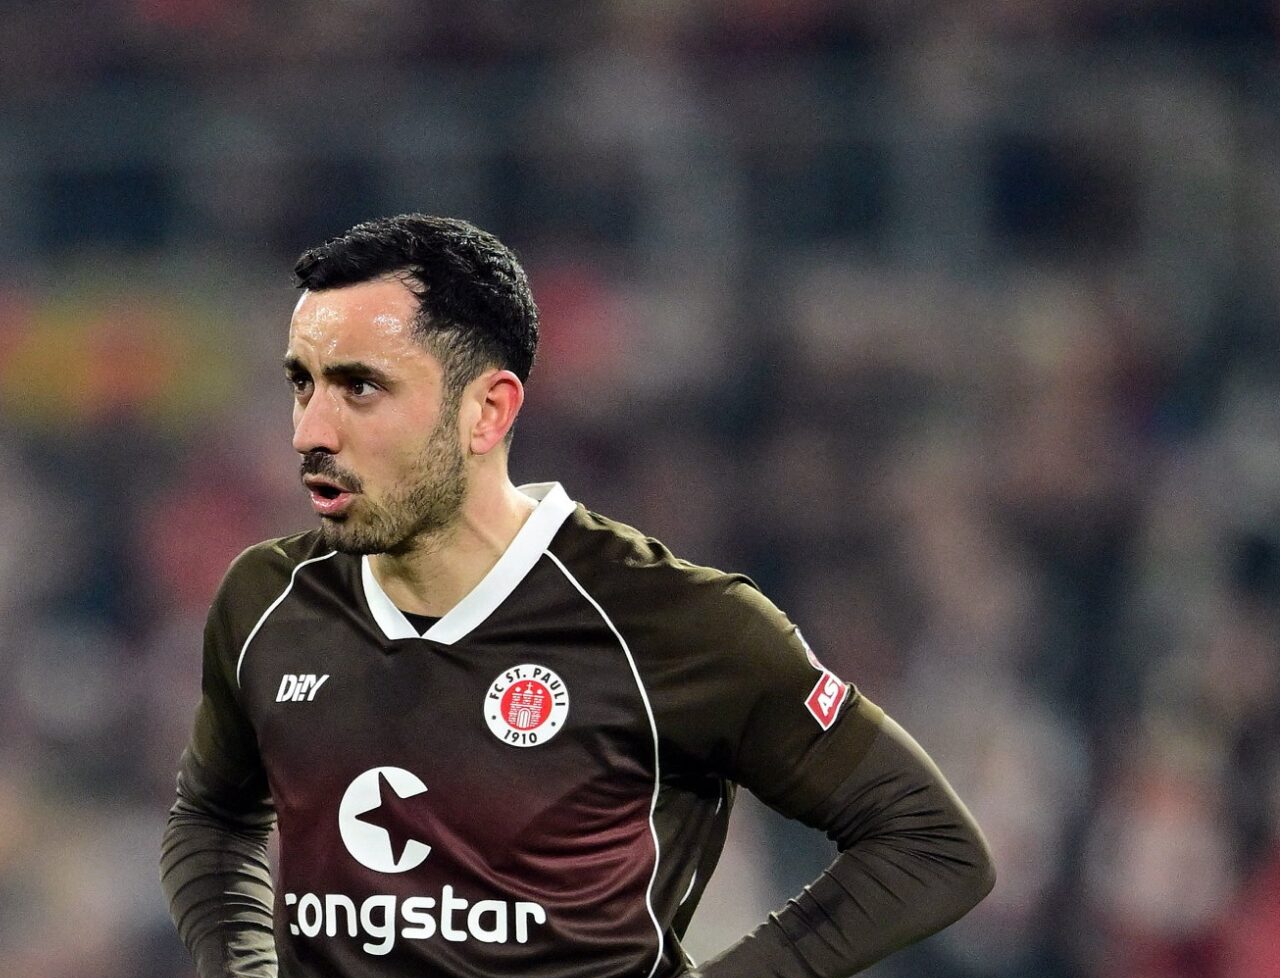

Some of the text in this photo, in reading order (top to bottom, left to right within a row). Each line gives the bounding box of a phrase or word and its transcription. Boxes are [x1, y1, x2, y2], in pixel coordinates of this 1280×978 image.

[489, 667, 566, 706] FC ST. PAULI
[503, 729, 538, 745] 1910
